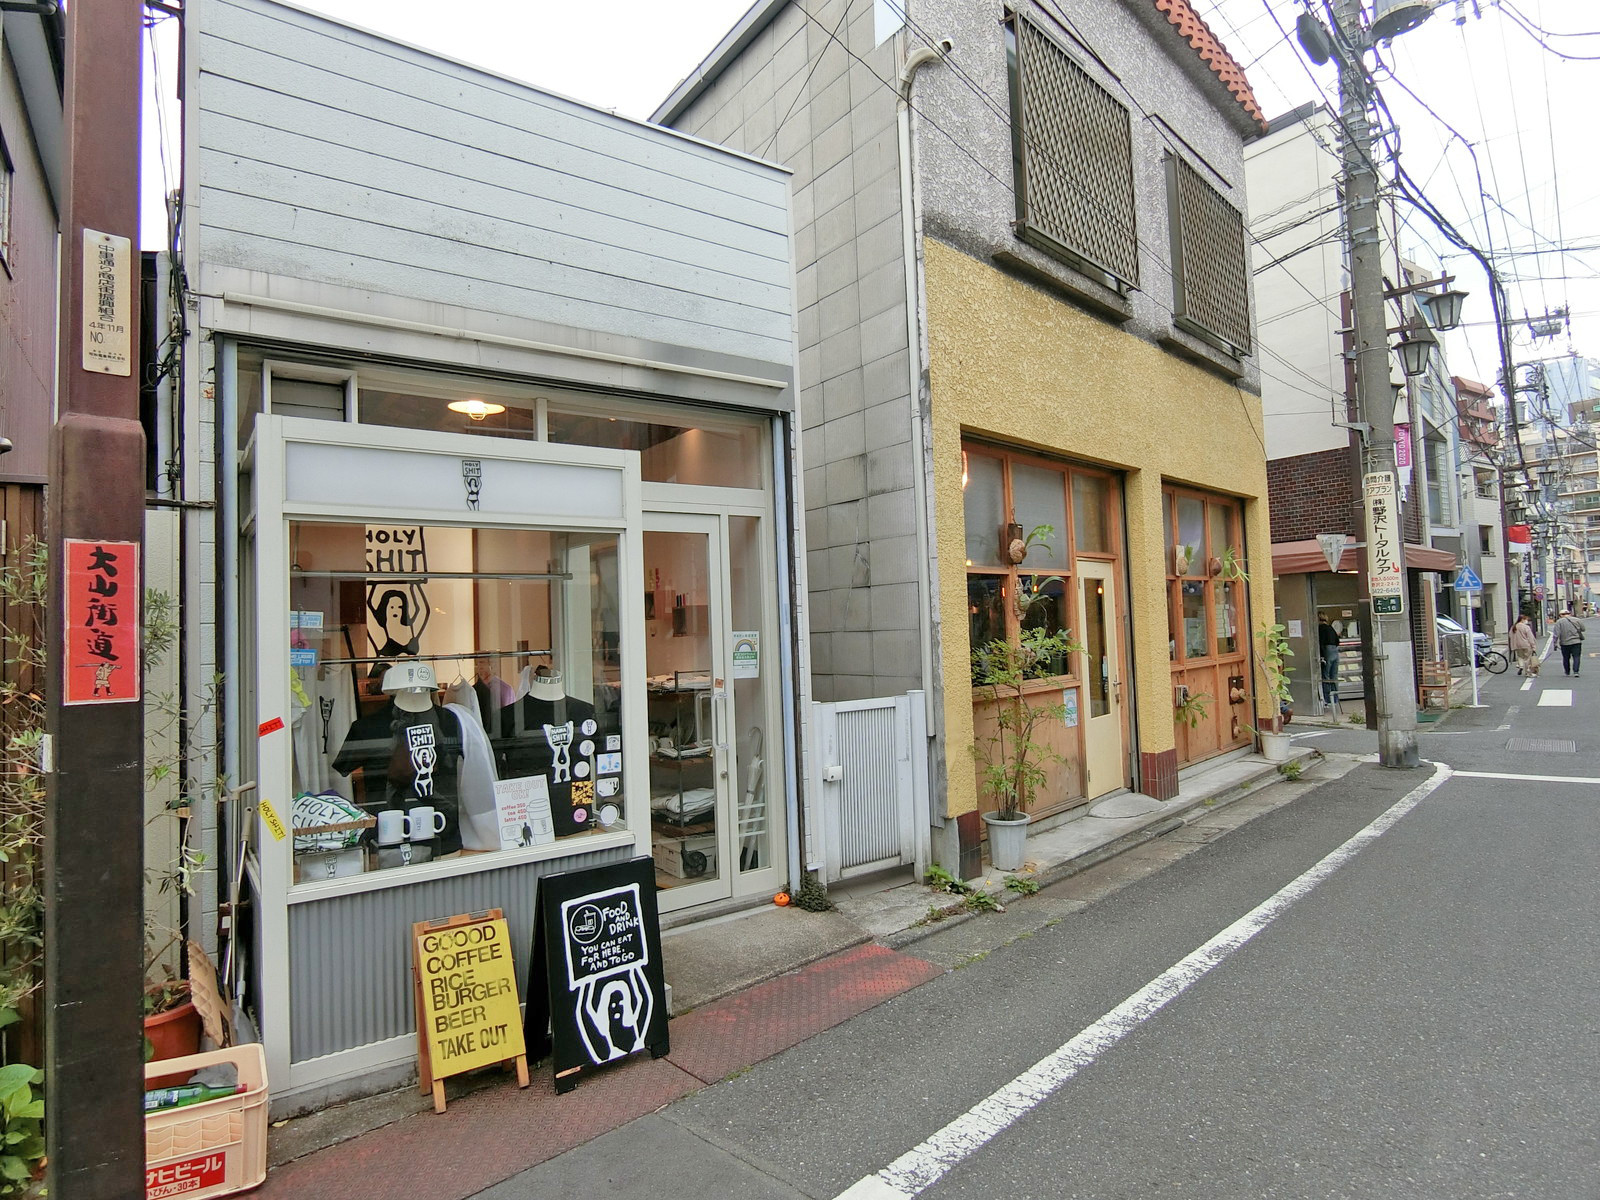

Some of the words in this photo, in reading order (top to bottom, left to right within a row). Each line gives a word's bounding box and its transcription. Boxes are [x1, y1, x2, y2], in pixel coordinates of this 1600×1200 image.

[1398, 429, 1406, 449] TOKYO
[465, 467, 481, 475] SHIT
[85, 546, 119, 661] 大山街道
[410, 726, 431, 736] HOLY
[411, 734, 433, 747] SHIT
[552, 733, 567, 742] SHIT
[496, 781, 523, 794] TAKE
[525, 779, 545, 791] OUT
[260, 801, 275, 819] HOLY
[297, 798, 341, 819] HOLY
[602, 901, 628, 922] FOOD
[615, 912, 631, 923] AND
[609, 916, 639, 935] DRINK
[423, 925, 496, 953] GOOOD
[581, 944, 599, 955] YOU
[601, 939, 616, 949] CAN
[618, 934, 633, 944] EAT
[426, 943, 503, 974] COFFEE
[581, 952, 600, 966] FOR
[590, 960, 608, 971] AND
[621, 952, 635, 962] GO
[430, 969, 476, 995] RICE
[432, 977, 512, 1011] BURGER
[435, 1005, 487, 1033] BEER
[437, 1031, 477, 1060] TAKE
[480, 1024, 509, 1049] OUT
